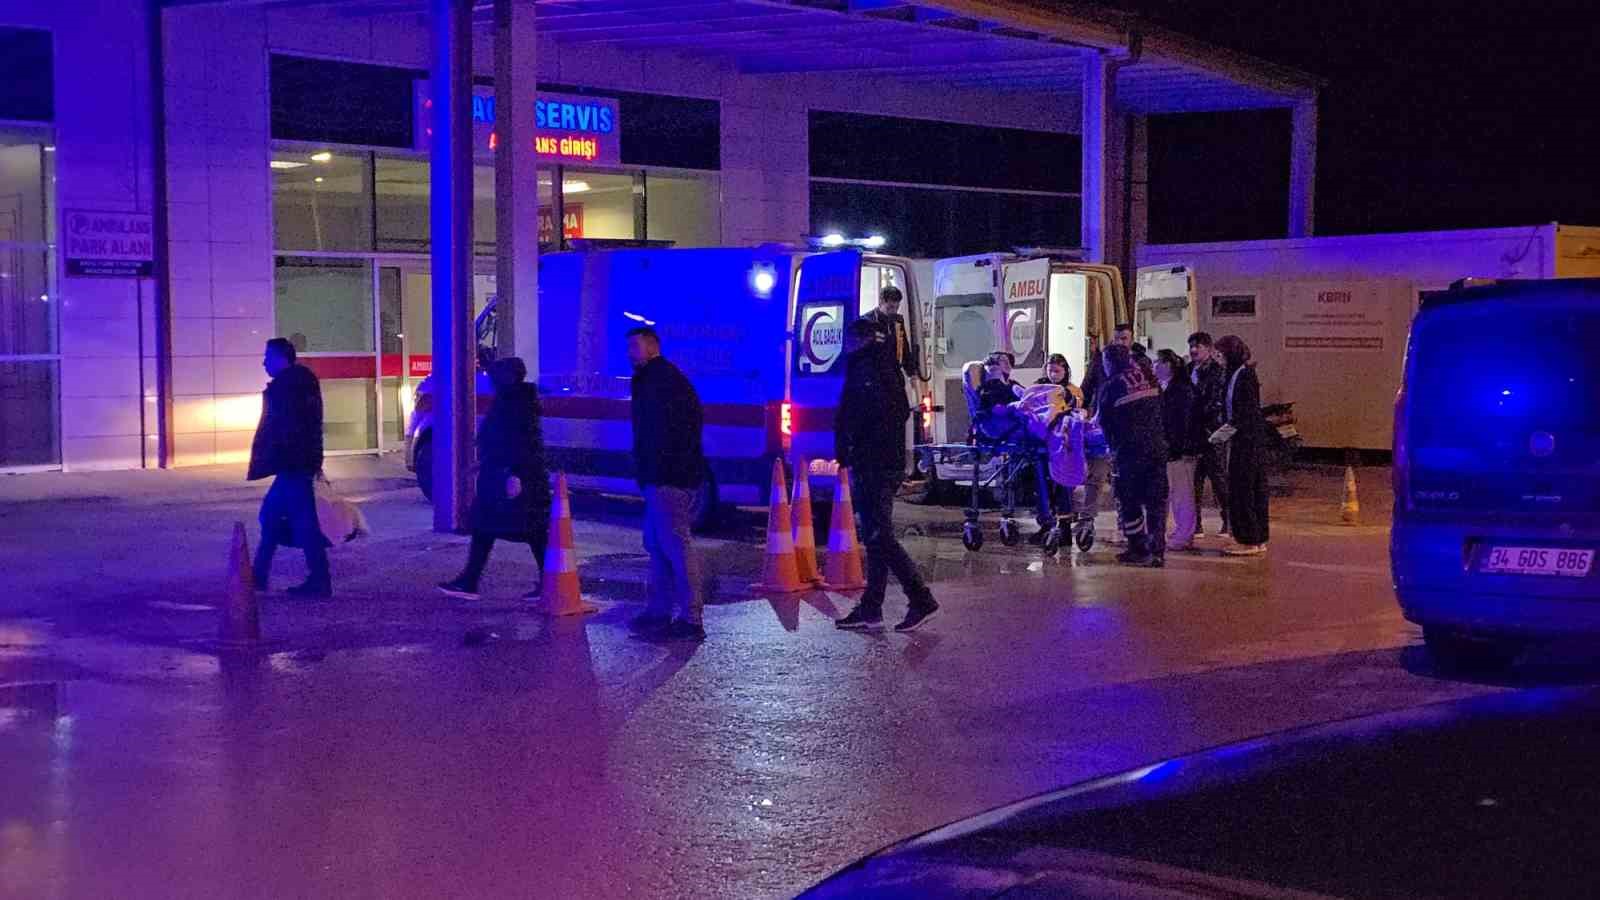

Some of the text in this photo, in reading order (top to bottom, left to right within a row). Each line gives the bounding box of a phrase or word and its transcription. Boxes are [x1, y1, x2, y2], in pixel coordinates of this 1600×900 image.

[71, 239, 107, 255] PARK
[1008, 279, 1045, 298] AMBU
[1492, 549, 1588, 570] 34 GDS 886
